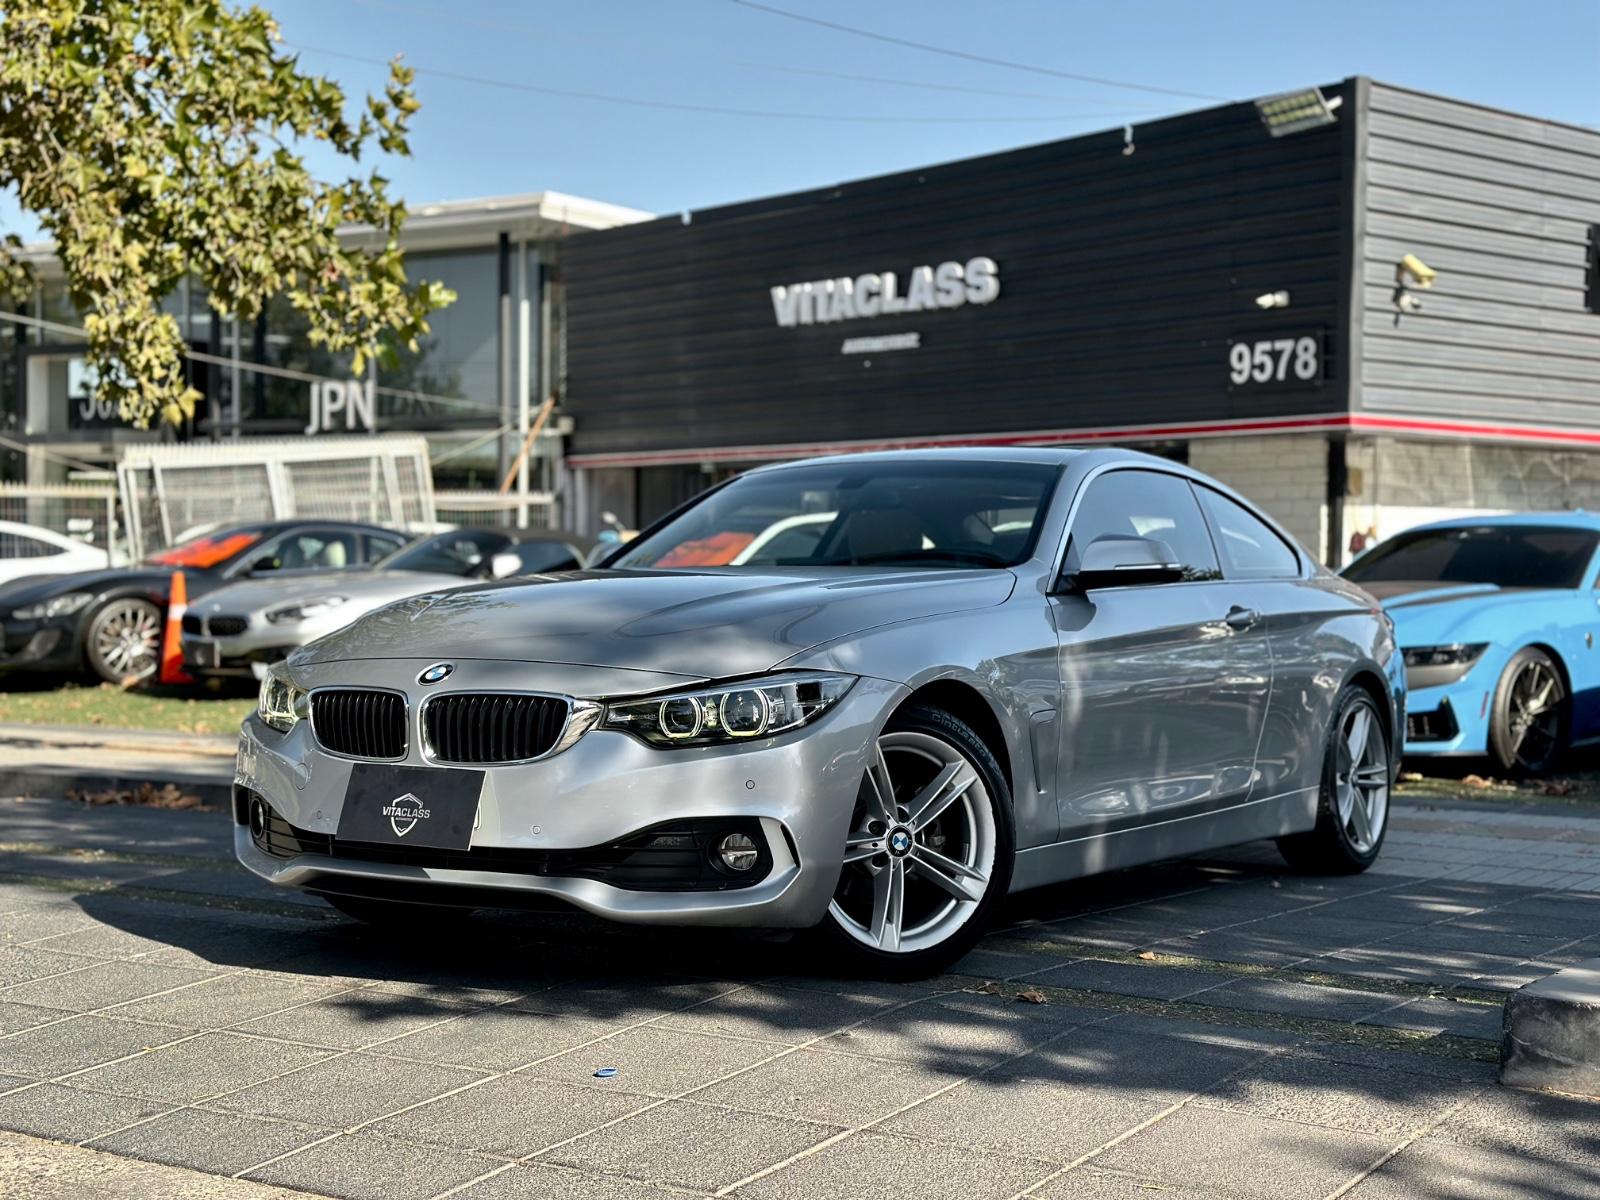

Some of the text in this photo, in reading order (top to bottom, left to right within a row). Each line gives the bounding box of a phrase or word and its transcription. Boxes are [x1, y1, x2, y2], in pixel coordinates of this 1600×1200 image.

[770, 256, 1000, 327] VITACLASS
[1230, 337, 1317, 384] 9578
[304, 379, 375, 435] JPN
[383, 806, 431, 819] VITACLASS
